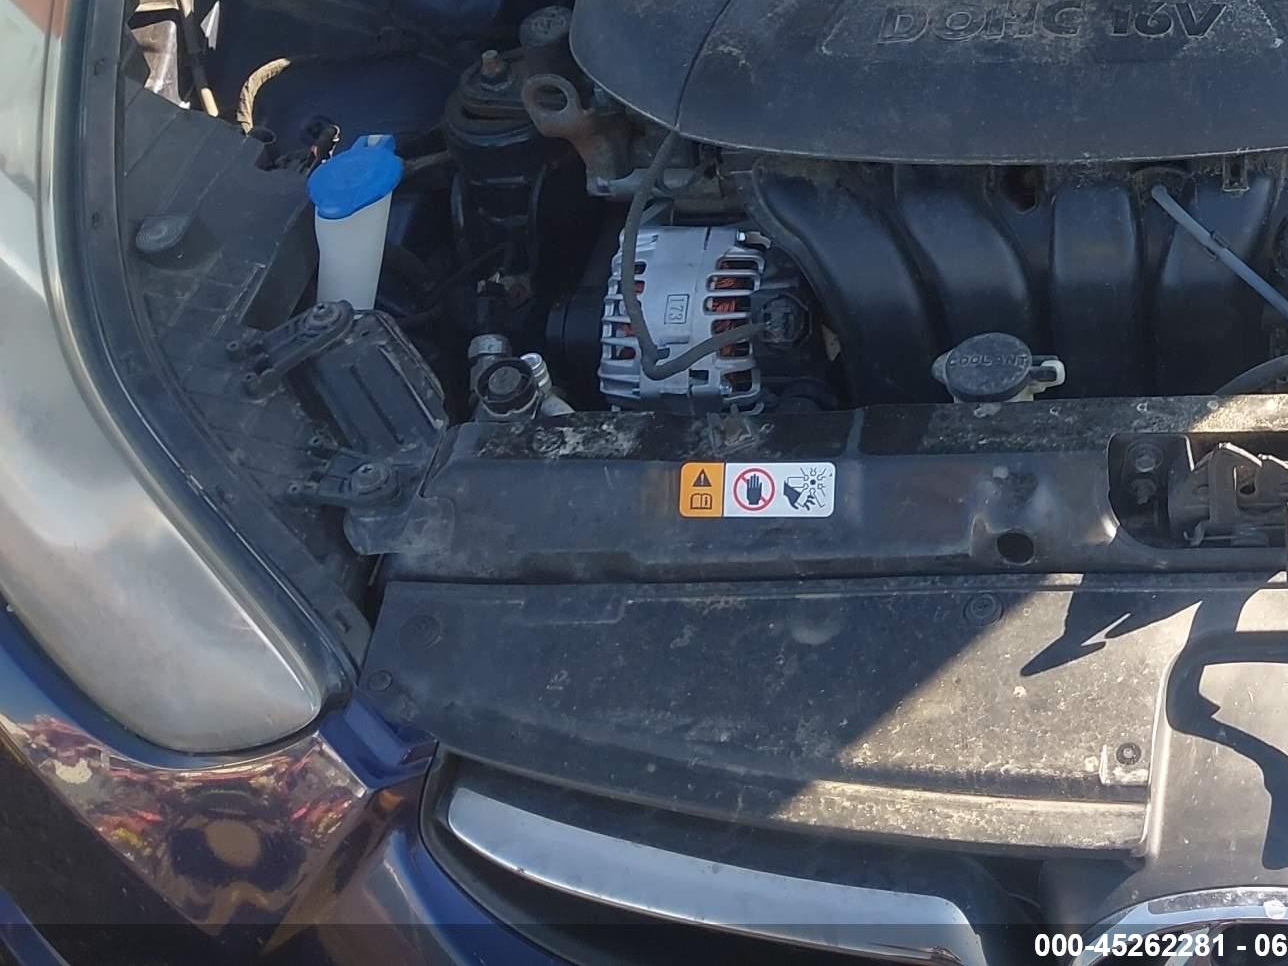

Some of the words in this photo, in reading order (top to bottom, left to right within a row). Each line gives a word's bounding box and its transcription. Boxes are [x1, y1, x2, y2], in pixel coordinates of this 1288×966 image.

[877, 1, 1085, 44] DOHC
[1108, 1, 1228, 39] 16V
[669, 297, 685, 321] 173
[949, 353, 1028, 368] COOLANT
